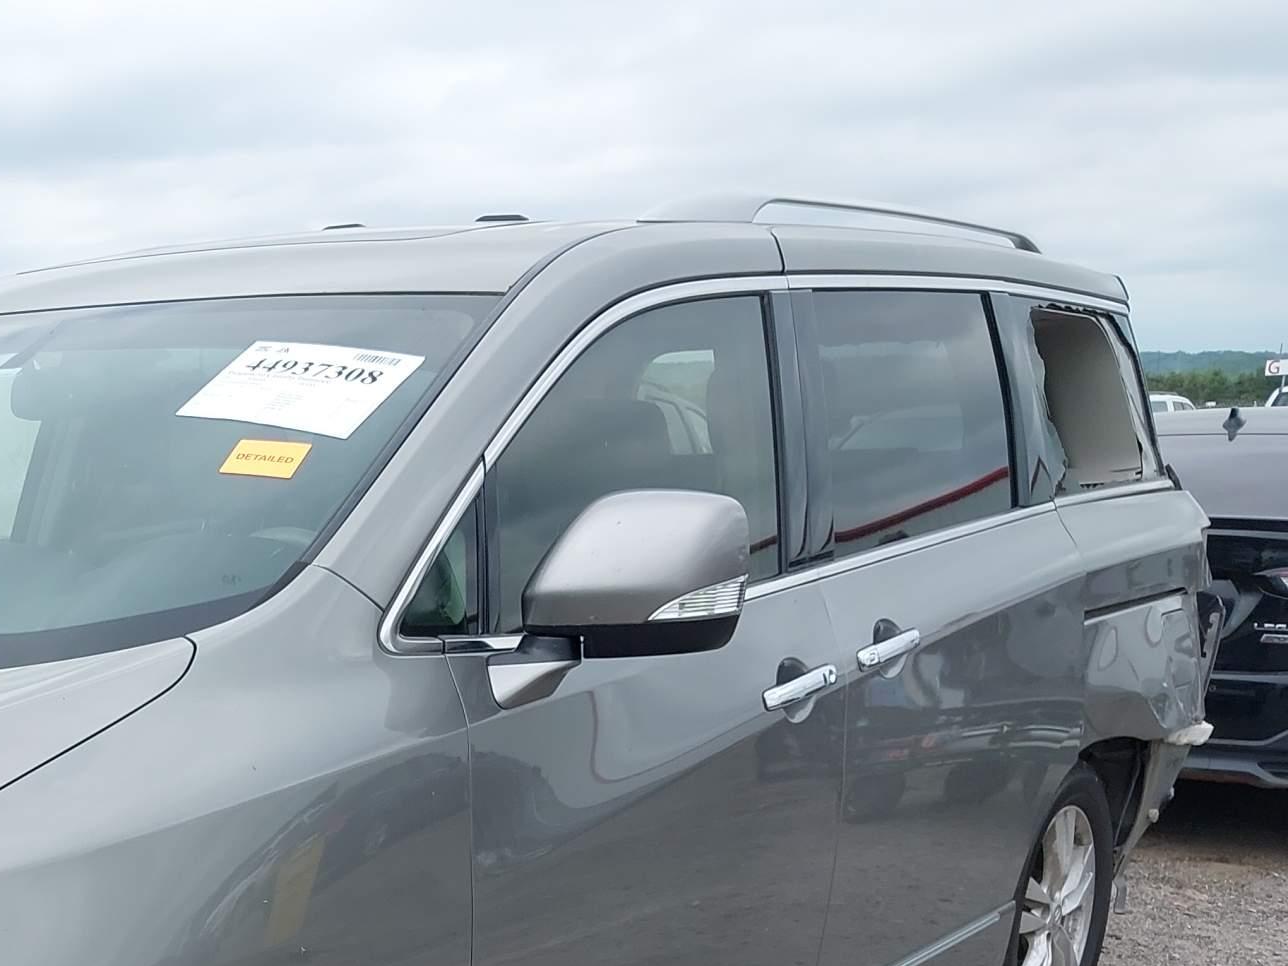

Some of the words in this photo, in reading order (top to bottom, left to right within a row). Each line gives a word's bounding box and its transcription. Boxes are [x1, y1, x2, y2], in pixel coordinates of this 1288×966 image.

[246, 358, 384, 385] 44937308
[1268, 360, 1281, 375] G
[235, 452, 294, 464] DETAILED
